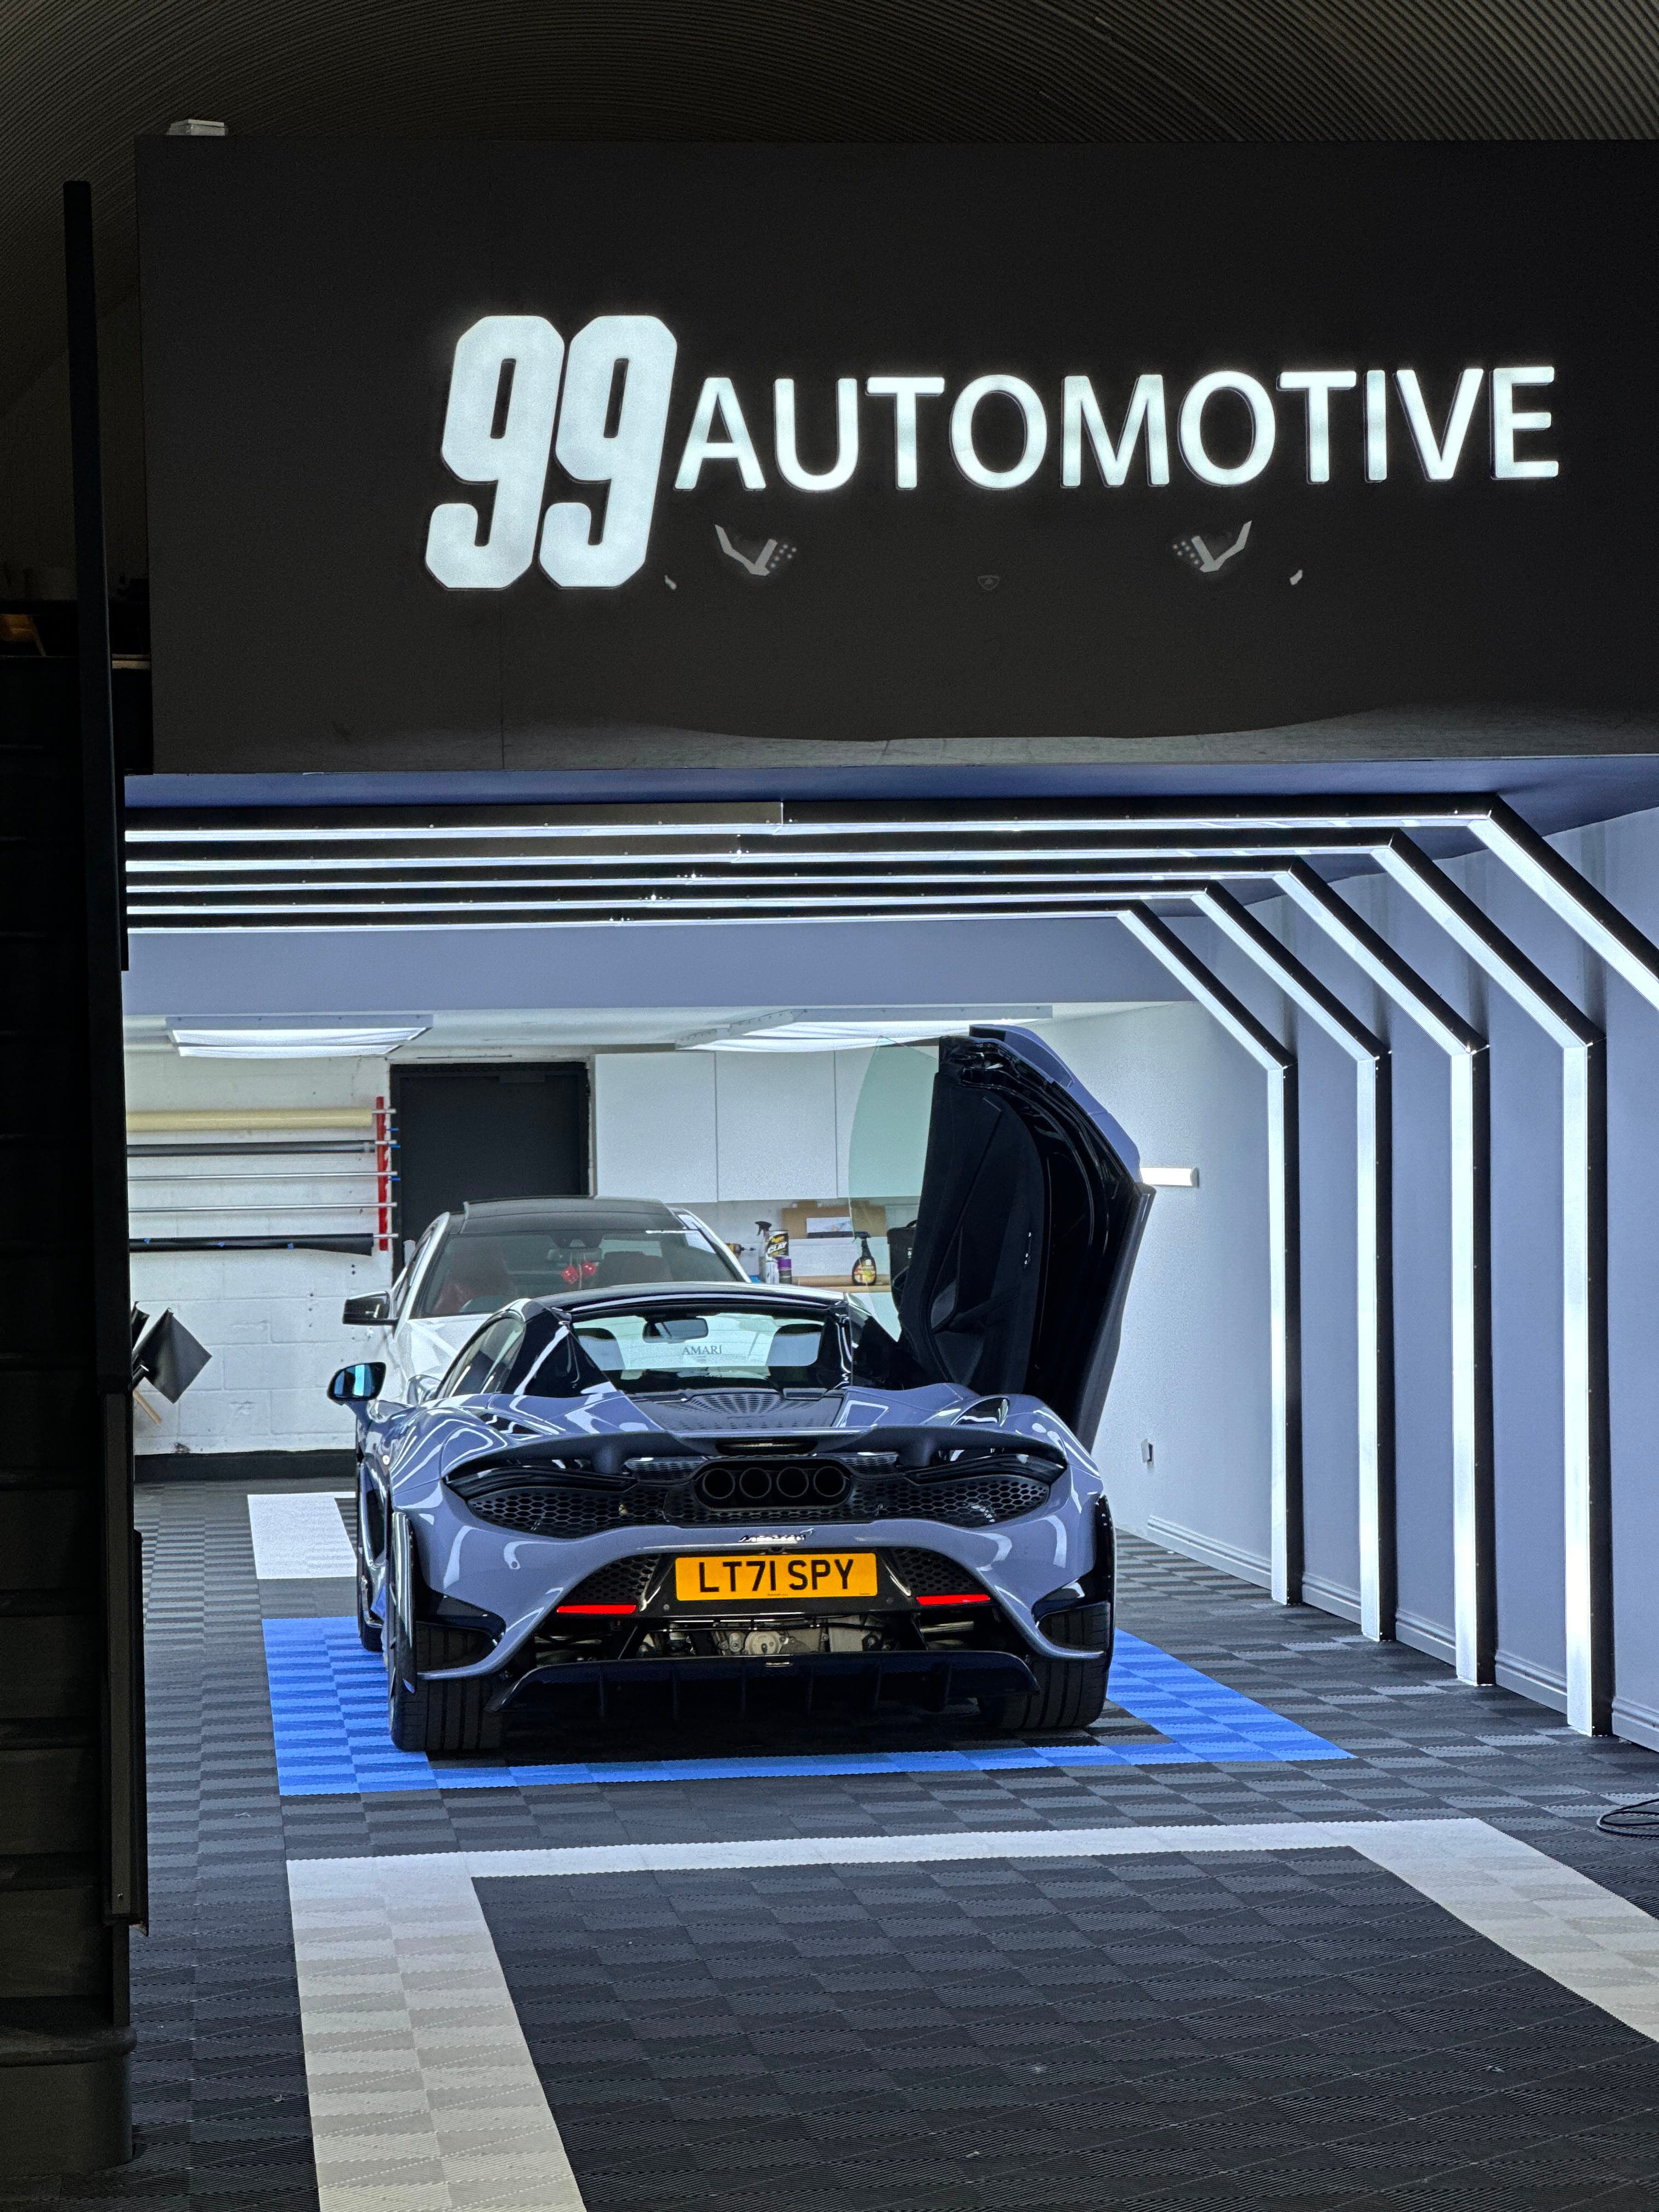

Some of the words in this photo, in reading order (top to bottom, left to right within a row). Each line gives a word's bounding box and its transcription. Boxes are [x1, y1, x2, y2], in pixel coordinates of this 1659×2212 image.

[425, 315, 678, 589] 99
[675, 366, 1560, 492] AUTOMOTIVE
[681, 1344, 723, 1355] AMARI
[699, 1560, 776, 1593] LT71
[788, 1559, 854, 1590] SPY
